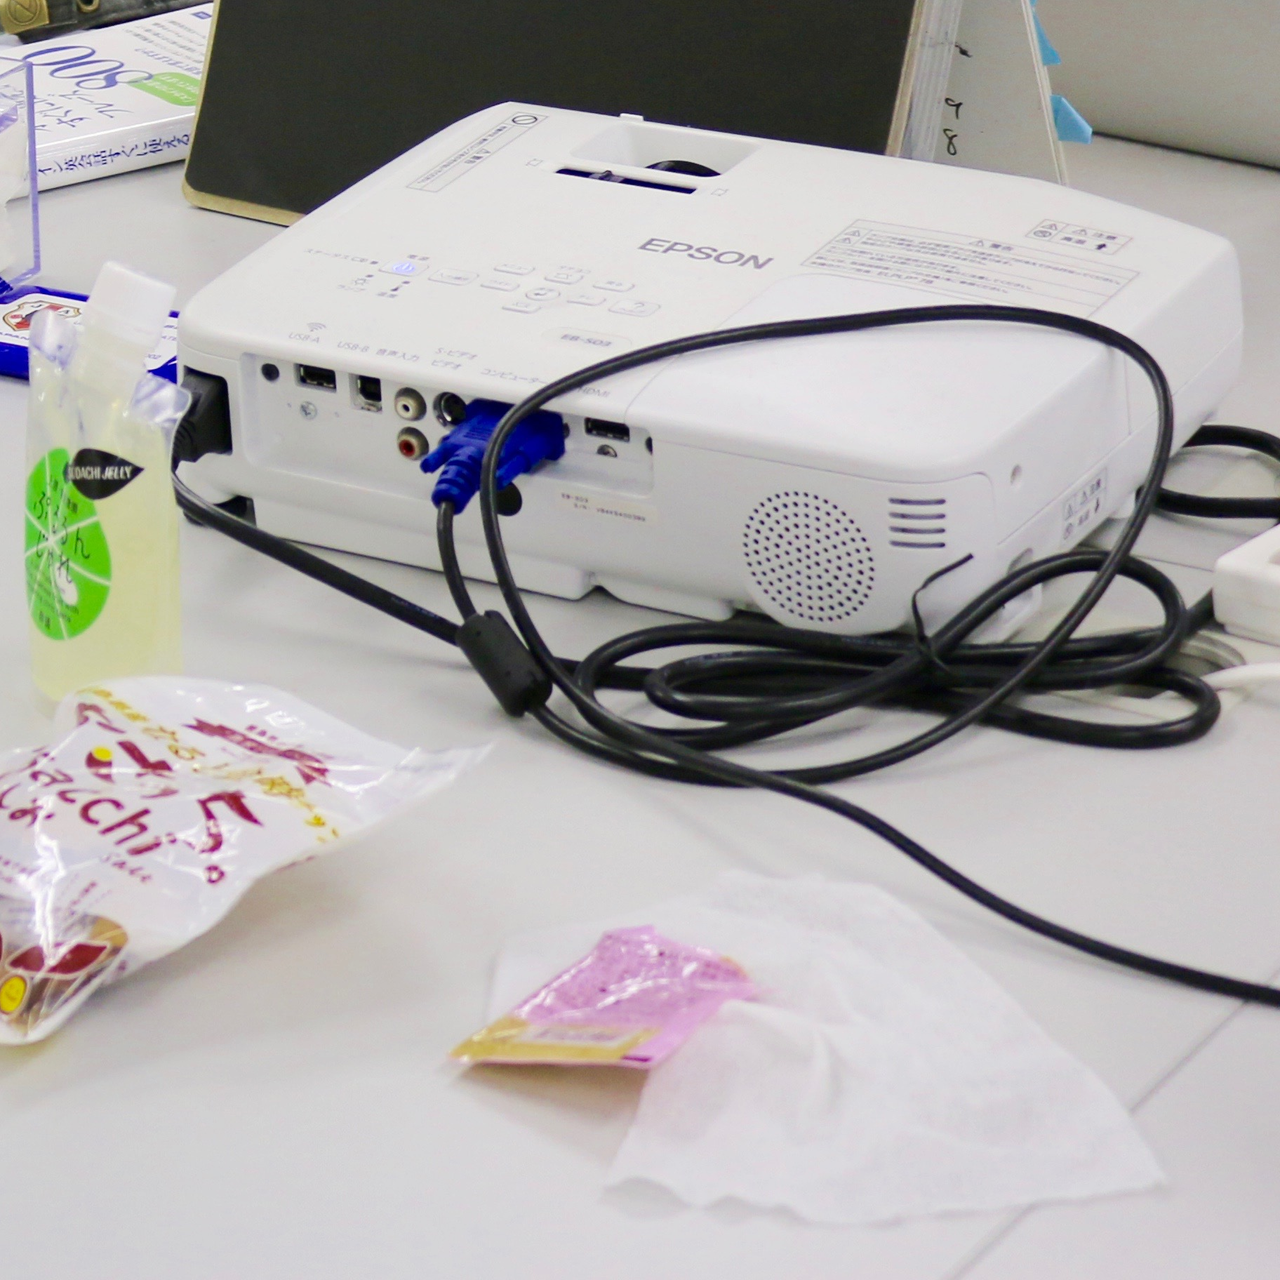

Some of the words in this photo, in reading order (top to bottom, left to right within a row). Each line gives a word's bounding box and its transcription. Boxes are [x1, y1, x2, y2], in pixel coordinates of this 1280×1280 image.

[23, 46, 153, 90] 800
[58, 89, 134, 118] フレーズ
[637, 237, 774, 270] EPSON
[288, 332, 321, 345] USB-A
[337, 340, 371, 355] USB-B
[430, 358, 463, 370] ビデオ
[101, 465, 134, 480] JELLY
